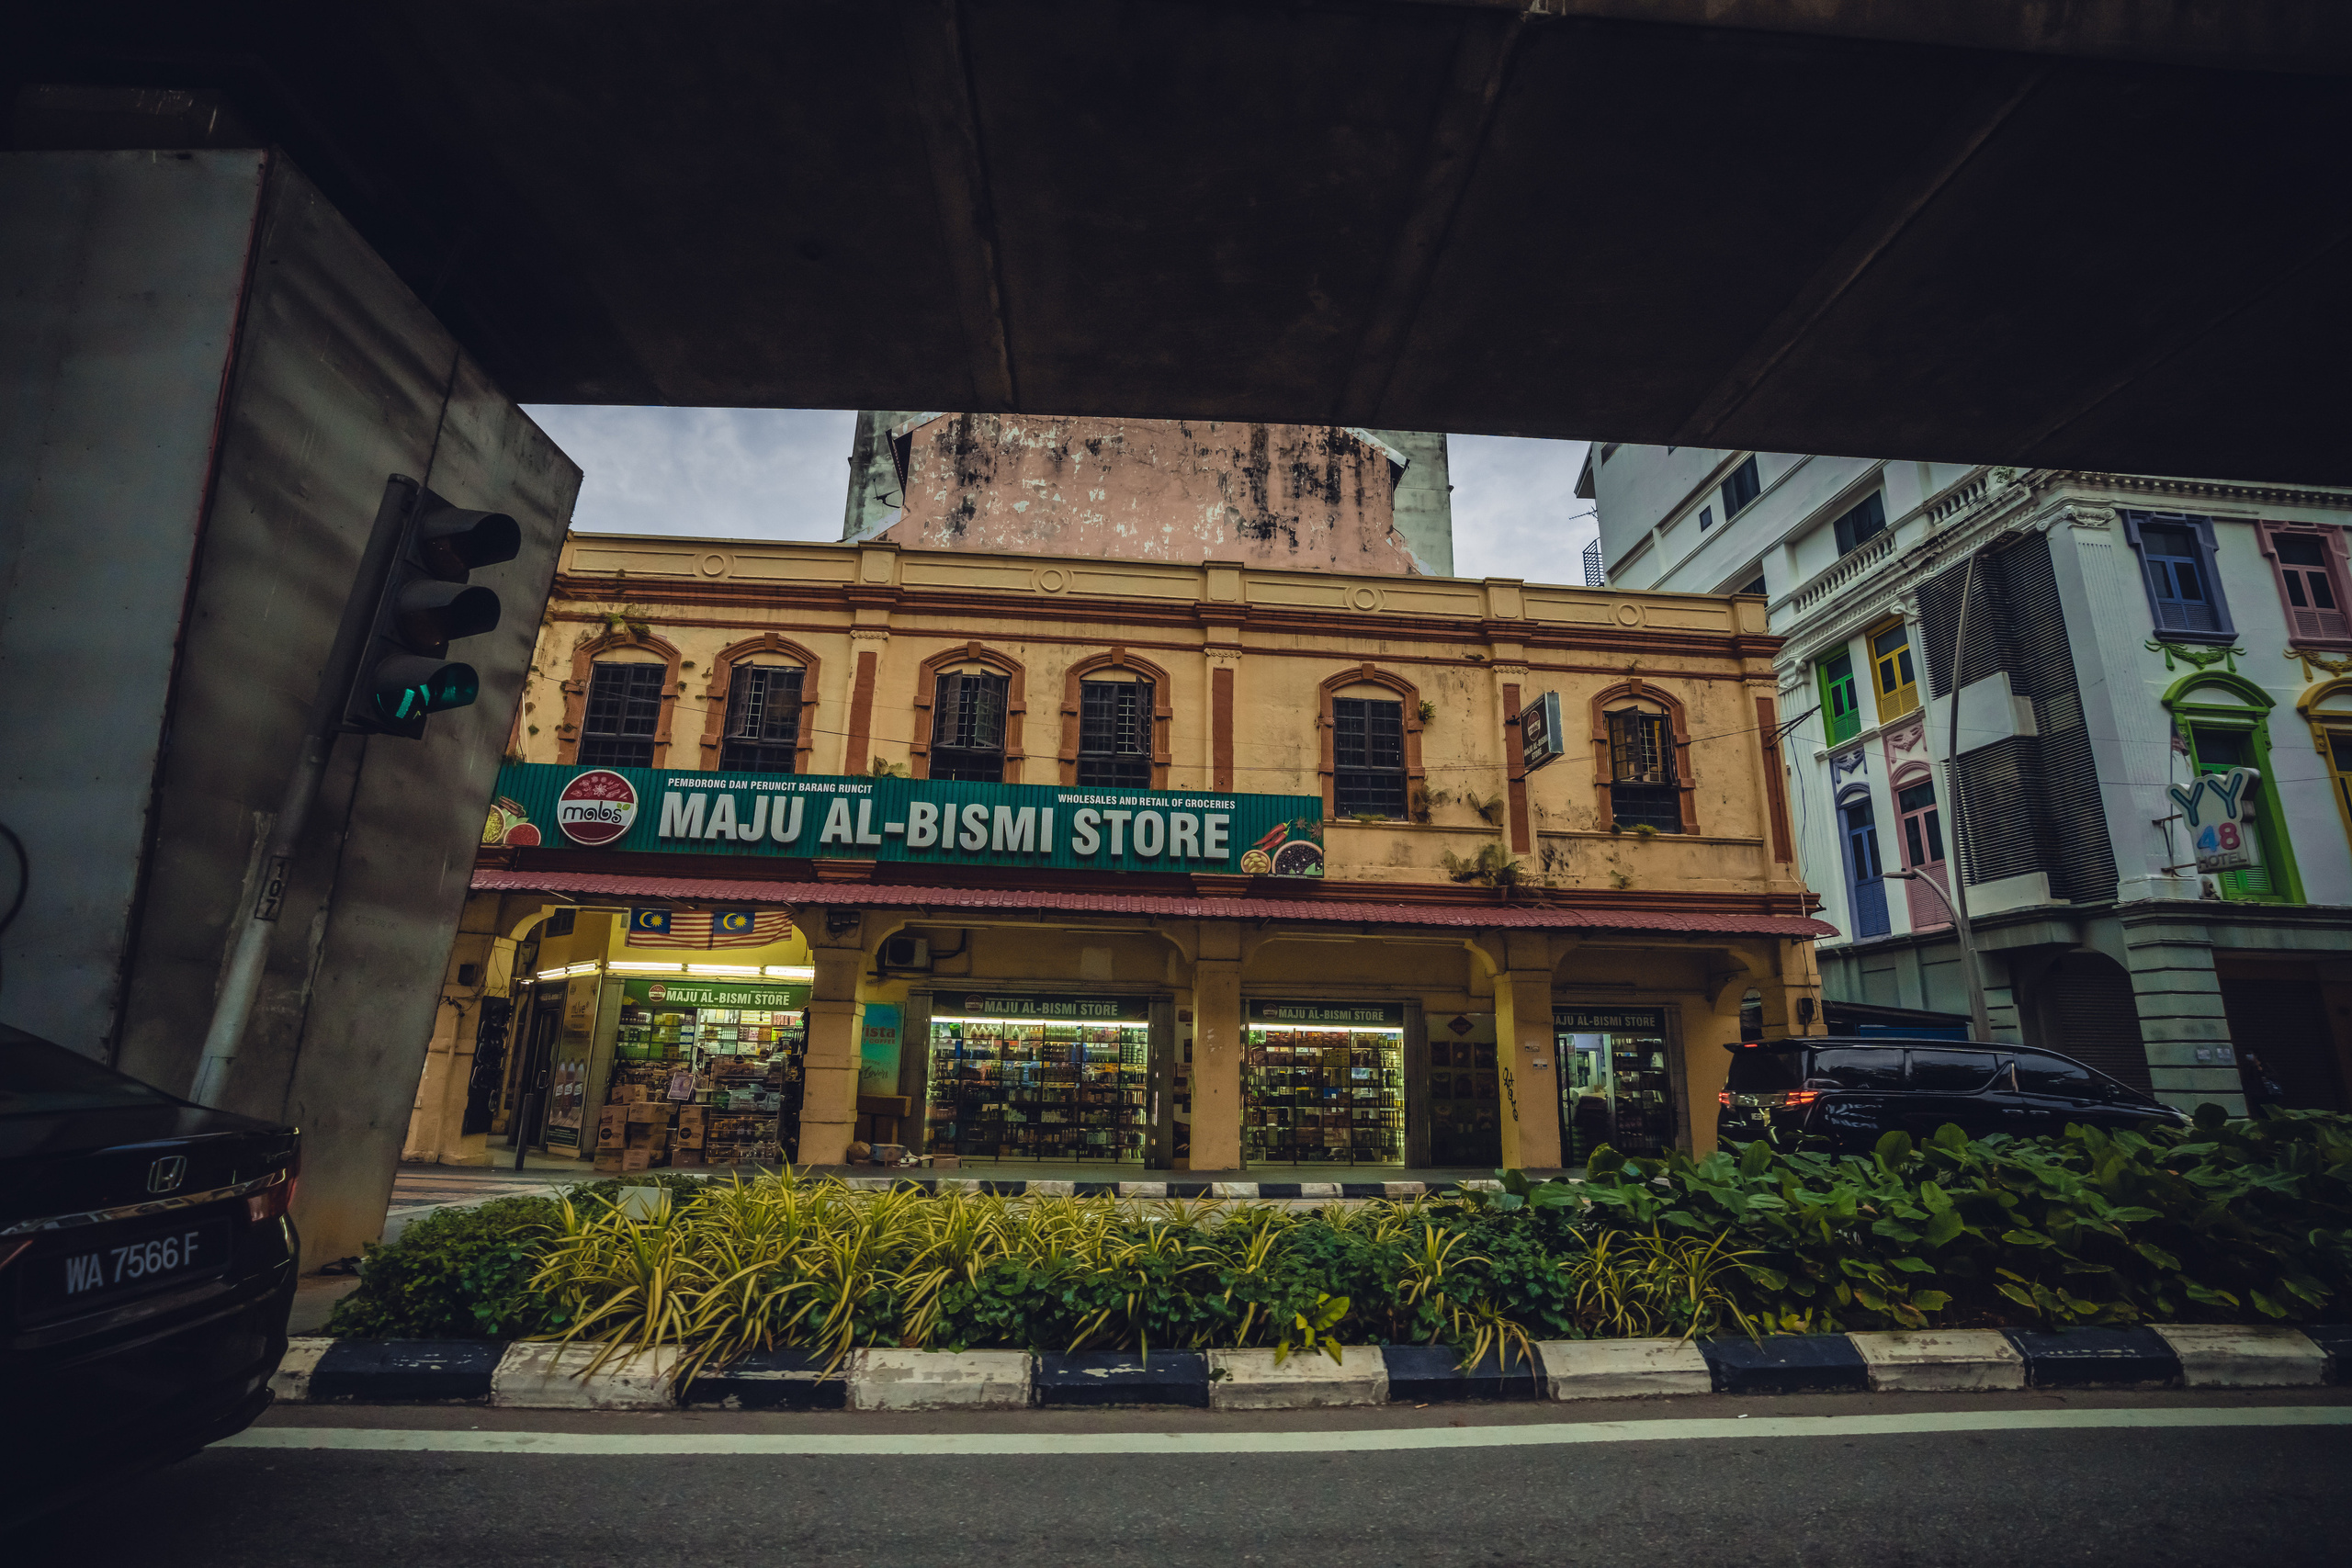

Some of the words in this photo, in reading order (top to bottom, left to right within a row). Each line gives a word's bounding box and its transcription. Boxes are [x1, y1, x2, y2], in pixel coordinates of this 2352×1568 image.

[668, 778, 726, 789] PEMBORONG
[729, 781, 748, 790] DAN
[751, 781, 797, 791] PERUNCIT
[798, 783, 835, 793] BARANG
[838, 784, 873, 794] RUNCIT
[1057, 794, 1117, 805] WHOLESALES
[1119, 796, 1137, 806] AND
[1139, 797, 1169, 807] RETAIL
[1171, 798, 1183, 807] OF
[1185, 799, 1236, 809] GROCERIES
[2170, 773, 2244, 827] YY
[562, 800, 622, 823] mabs
[659, 792, 805, 843] MAJU
[820, 797, 1054, 853] AL-BISMI
[1071, 808, 1230, 859] STORE
[2197, 822, 2241, 852] 48
[2197, 852, 2247, 869] HOTEL
[666, 990, 697, 1002] MAJU
[700, 992, 752, 1005] AL-BISMI
[754, 993, 790, 1006] STORE
[985, 1000, 1018, 1013] MAJU
[1022, 1001, 1076, 1015] AL-BISMI
[1080, 1003, 1118, 1016] STORE
[1279, 1009, 1305, 1019] MAJU
[1308, 1010, 1351, 1021] AL-BISMI
[1354, 1010, 1385, 1021] STORE
[1553, 1015, 1574, 1026] AJU
[1577, 1016, 1622, 1026] AL-BISMI
[1625, 1017, 1656, 1027] STORE
[862, 1024, 896, 1038] ista
[65, 1254, 104, 1294] WA
[110, 1237, 179, 1283] 7566
[185, 1232, 199, 1266] F
